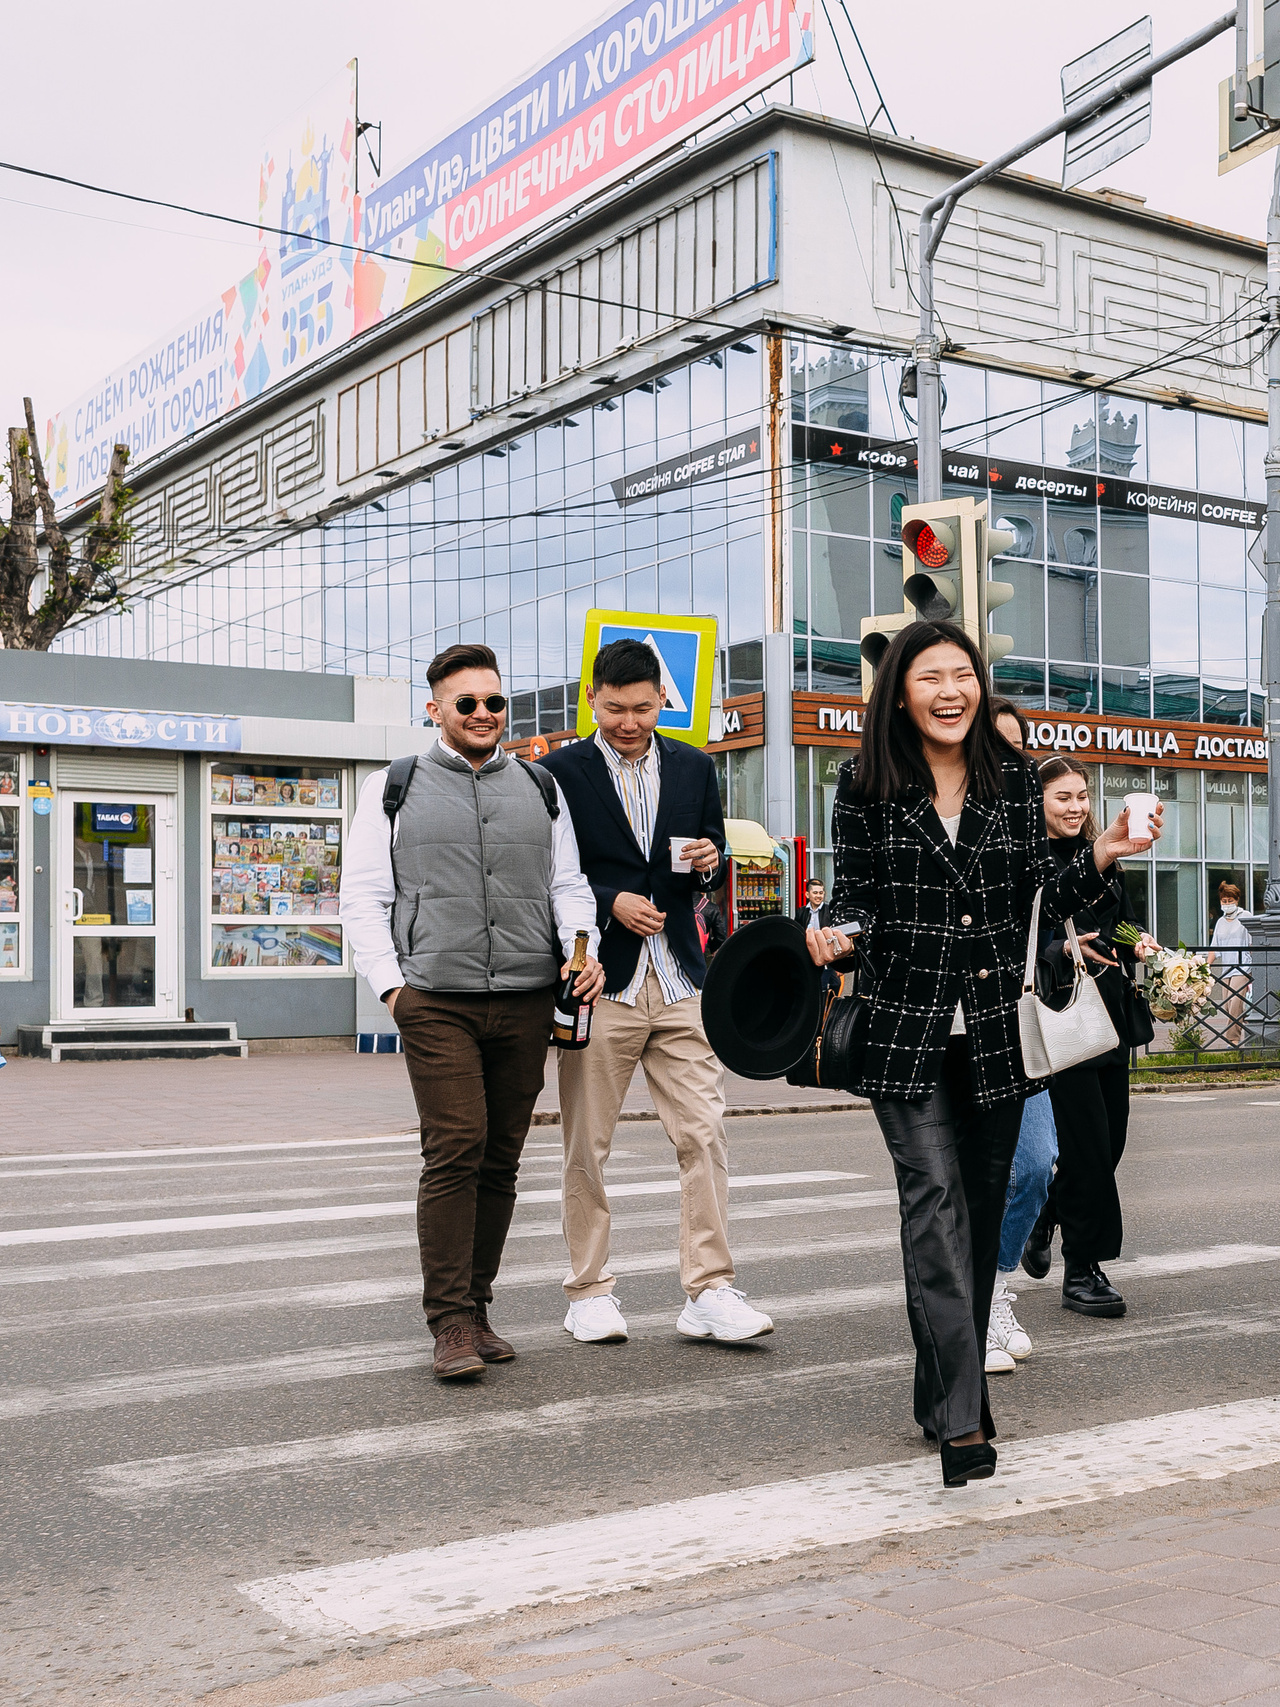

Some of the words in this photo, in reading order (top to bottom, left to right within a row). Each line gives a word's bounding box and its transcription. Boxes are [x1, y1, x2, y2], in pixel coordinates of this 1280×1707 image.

[469, 80, 551, 179] ЦВЕТИ
[557, 60, 577, 118] И
[583, 0, 742, 100] ХОРОШ
[450, 110, 607, 251] СОЛНЕЧНАЯ
[614, 0, 783, 147] СТОЛИЦА!
[282, 280, 334, 368] 355
[74, 408, 82, 443] С
[84, 375, 124, 444] ДНЁМ
[129, 308, 228, 408] РОЖДЕНИЯ,
[162, 364, 223, 439] ГОРОД!
[625, 470, 672, 499] КОФЕЙНЯ
[673, 454, 715, 483] COFFEE
[717, 443, 746, 468] STAR
[857, 449, 908, 468] кофе
[947, 462, 980, 481] чай
[1014, 474, 1088, 498] десерты
[1126, 490, 1198, 516] КОФЕЙНЯ
[1201, 502, 1258, 526] COFFEE
[1096, 726, 1180, 759] ПИЦЦА
[1194, 735, 1280, 760] ДОСТАВ
[1206, 782, 1238, 797] ИЦЦА
[96, 813, 120, 822] ТАБАК
